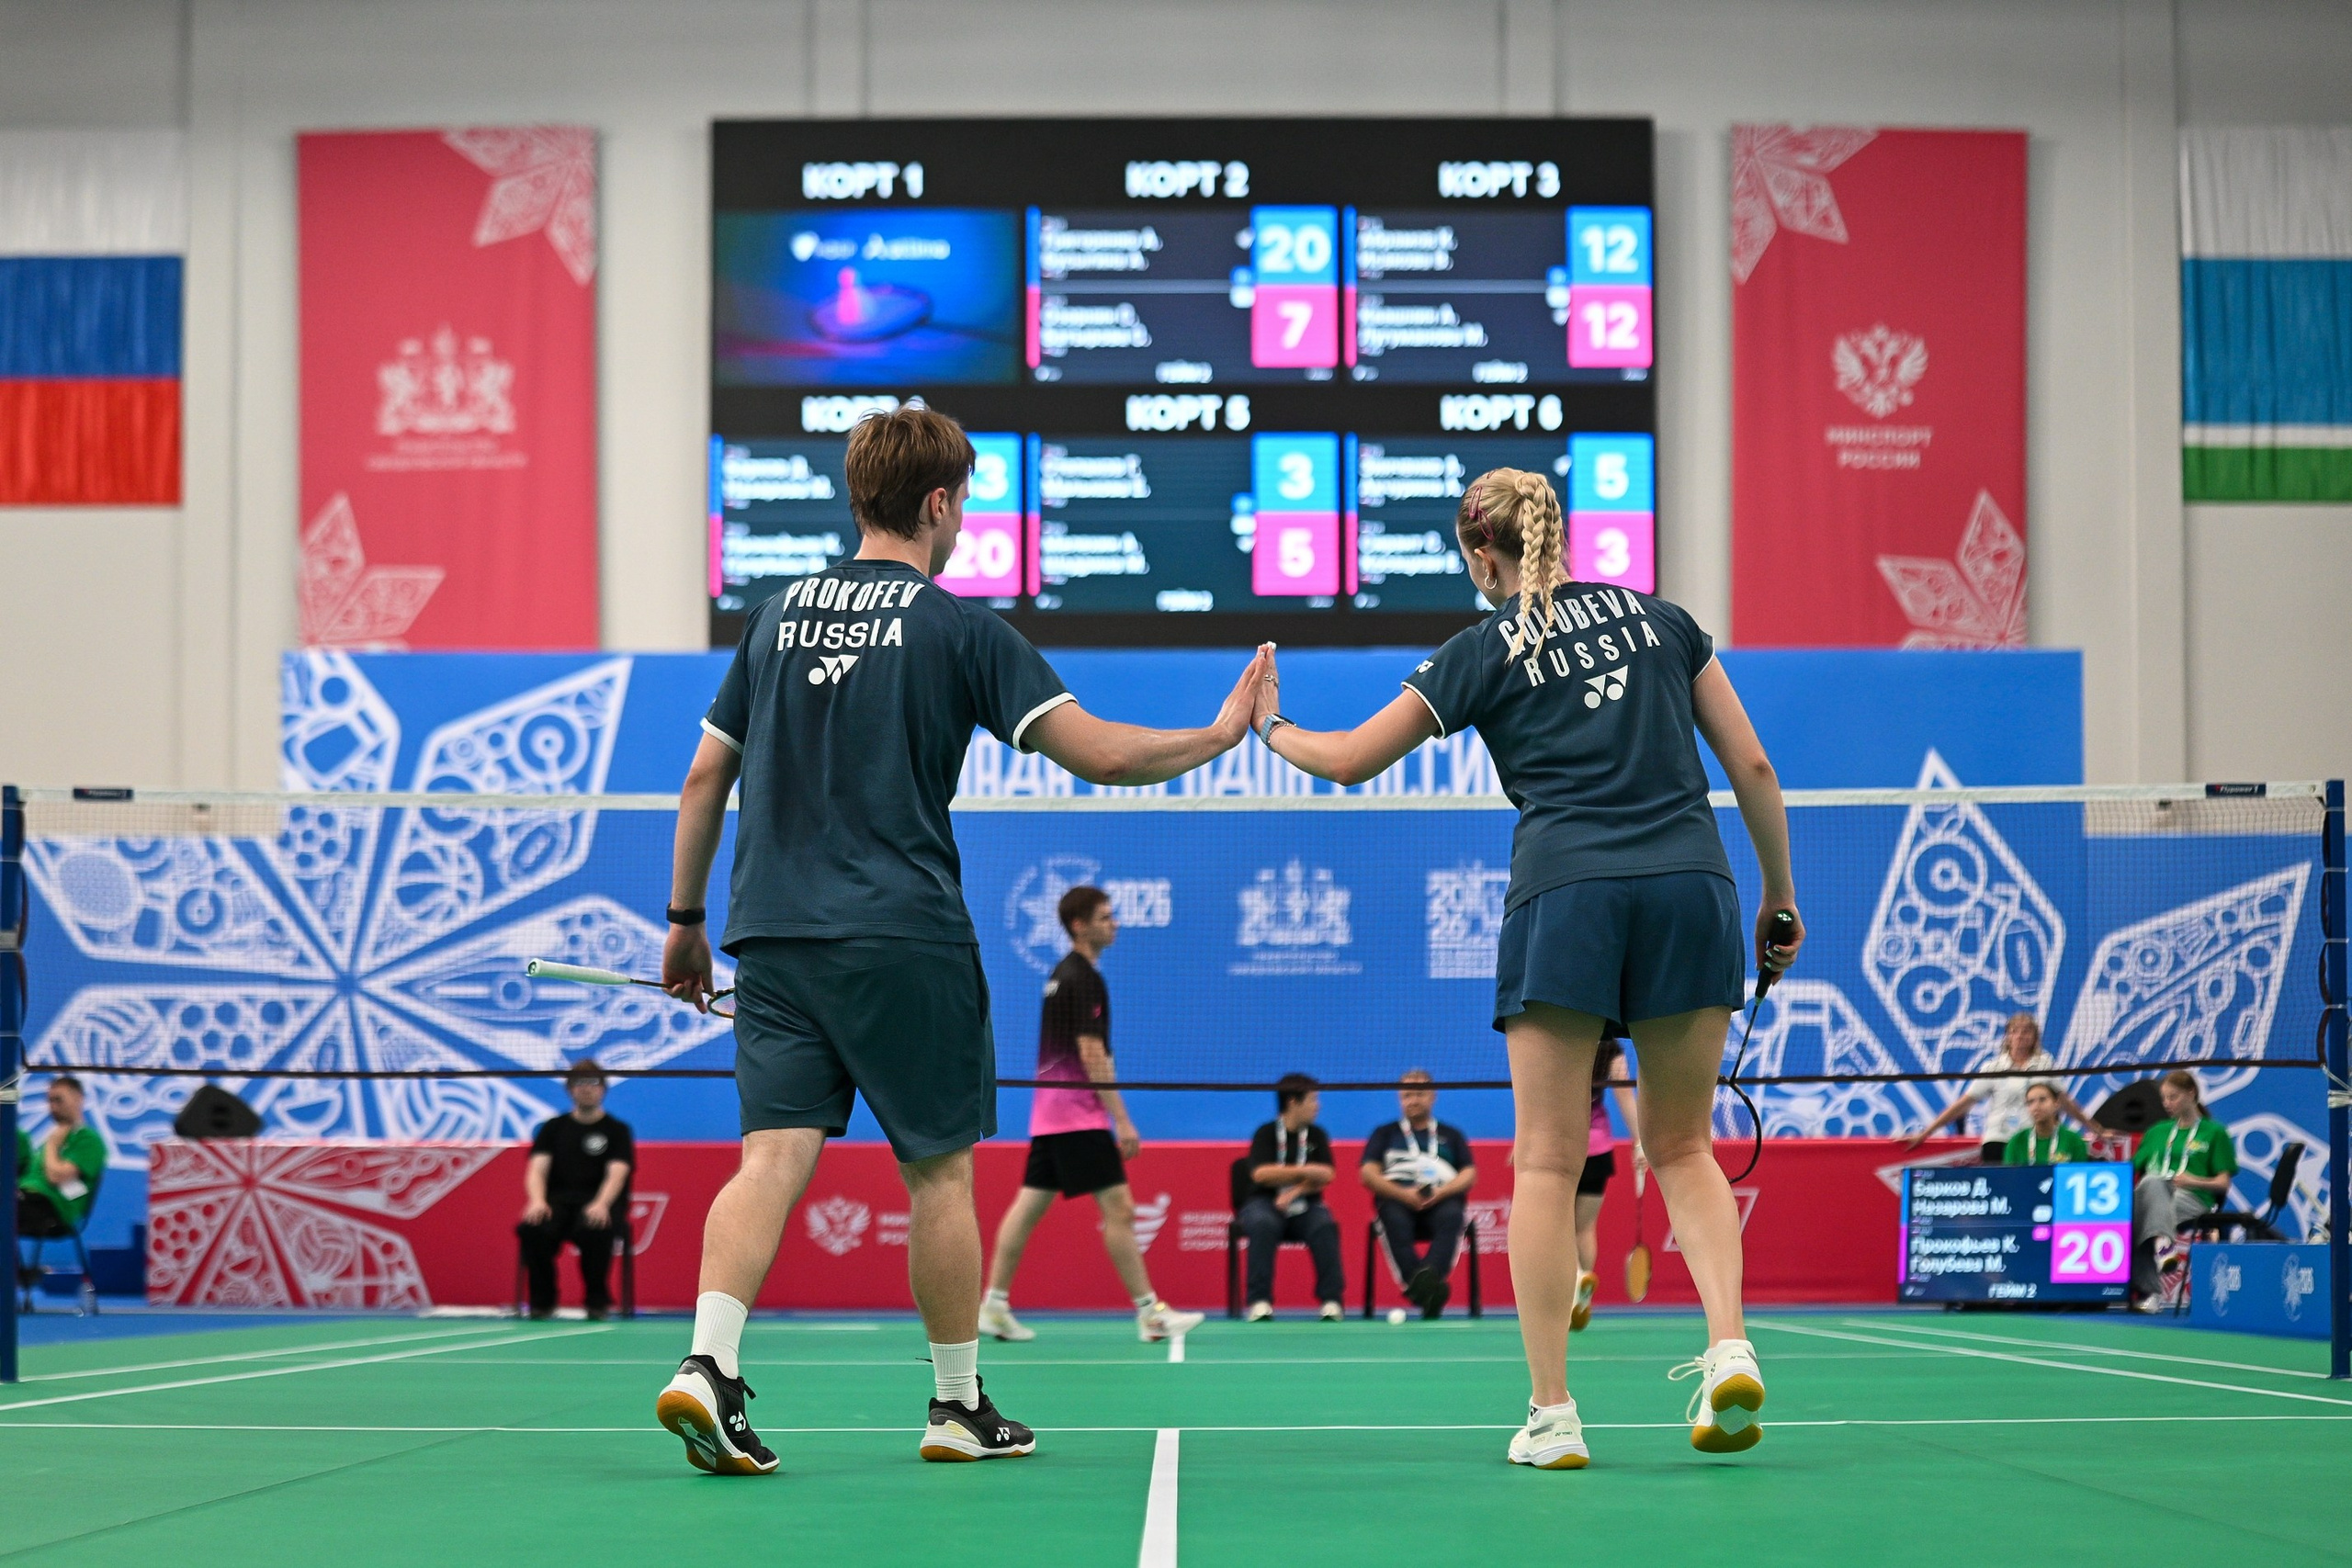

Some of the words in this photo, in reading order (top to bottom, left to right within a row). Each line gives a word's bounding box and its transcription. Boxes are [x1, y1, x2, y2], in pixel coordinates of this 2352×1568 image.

[902, 161, 923, 198] 1
[1224, 161, 1250, 197] 2
[1536, 161, 1560, 197] 3
[1259, 224, 1331, 273] 20
[1580, 224, 1638, 273] 12
[1277, 300, 1313, 349] 7
[1580, 300, 1639, 349] 12
[1225, 394, 1250, 432] 5
[1537, 394, 1563, 431] 6
[968, 453, 1009, 501] 3
[1277, 452, 1315, 500] 3
[1594, 453, 1629, 500] 5
[941, 528, 1015, 579] 20
[1277, 528, 1315, 578] 5
[1594, 528, 1630, 577] 3
[784, 578, 925, 612] PROKOFEV
[777, 617, 902, 651] RUSSIA
[1523, 621, 1661, 687] RUSSIA
[1990, 1196, 2012, 1214] М.
[2066, 1170, 2120, 1215] 13
[1910, 1235, 2000, 1256] Прокофьев
[1910, 1255, 1984, 1276] Голубева
[1984, 1255, 2007, 1273] М.
[2058, 1230, 2124, 1275] 20
[2025, 1283, 2037, 1298] 2
